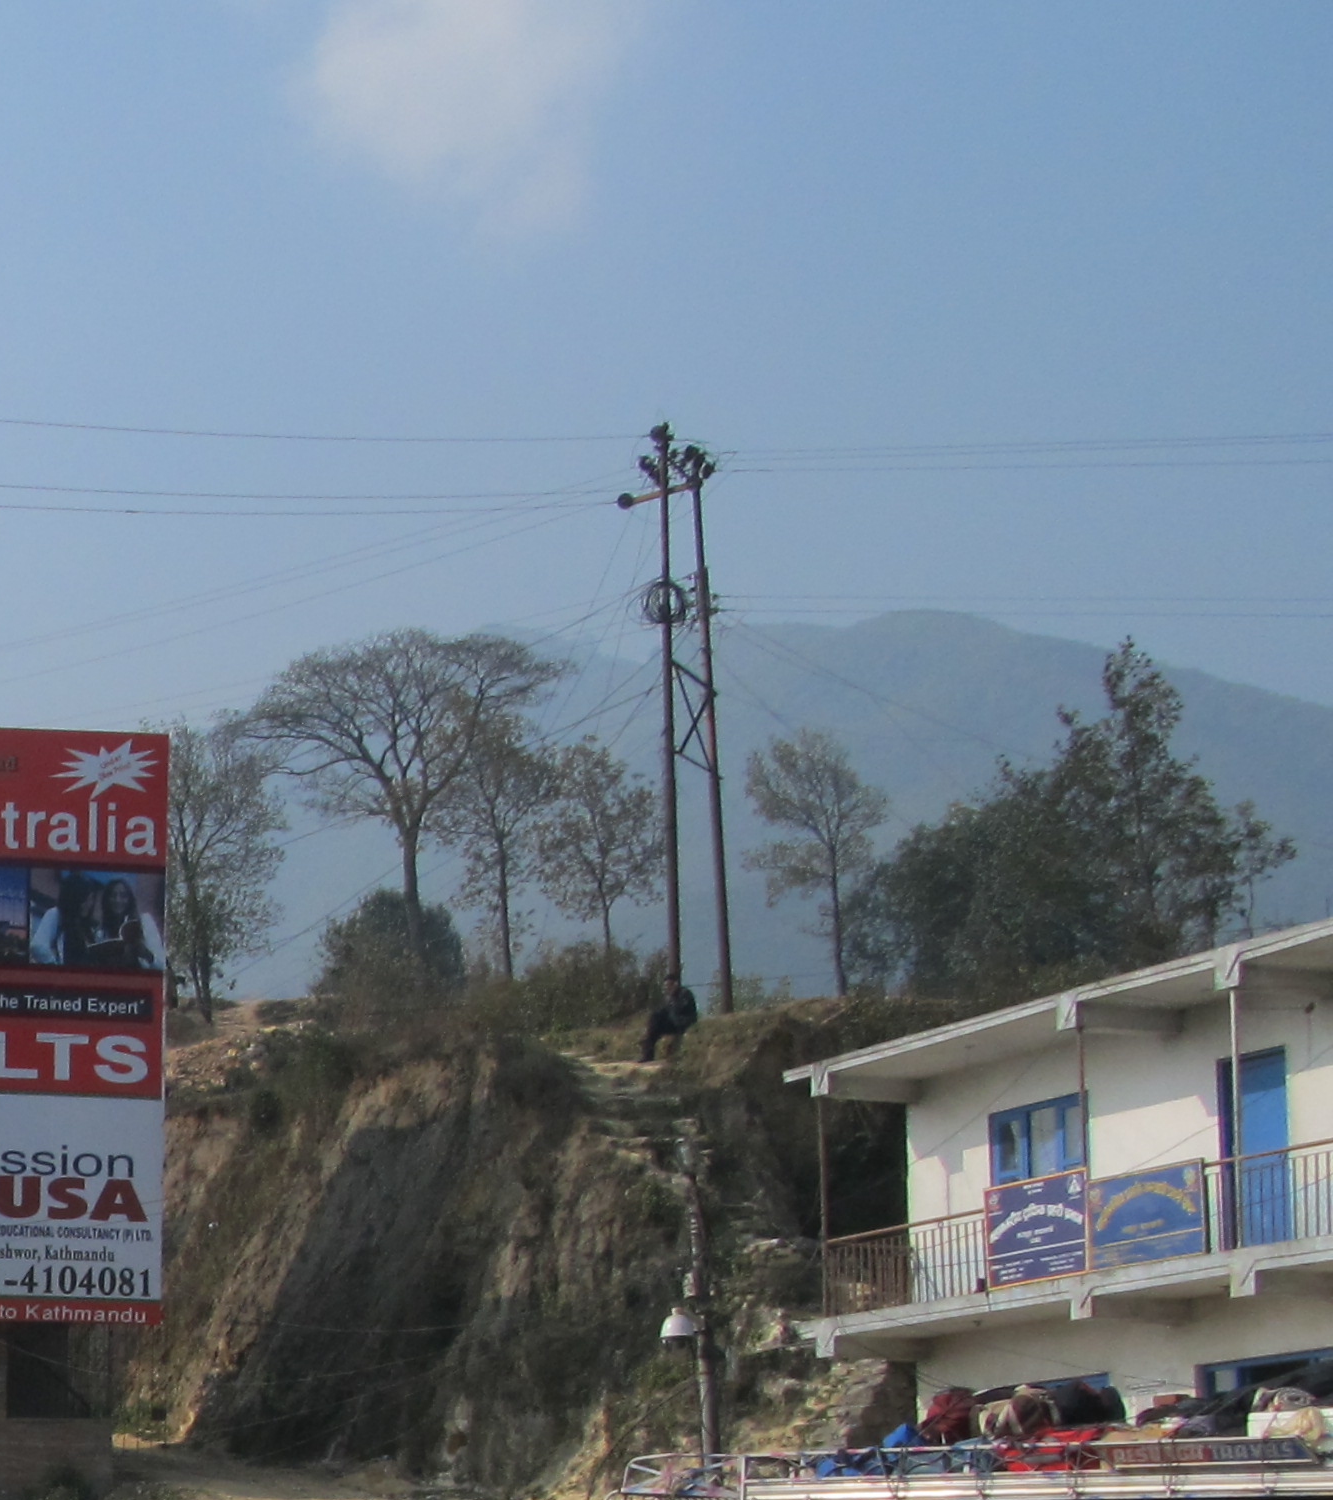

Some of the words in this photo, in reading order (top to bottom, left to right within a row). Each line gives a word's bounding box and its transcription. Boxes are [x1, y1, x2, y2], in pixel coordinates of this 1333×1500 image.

[24, 996, 82, 1013] Trained
[57, 1226, 121, 1241] CONSULTANCY
[44, 1248, 115, 1262] Kathmandu
[0, 1304, 17, 1318] to
[25, 1304, 146, 1323] Kathmandu
